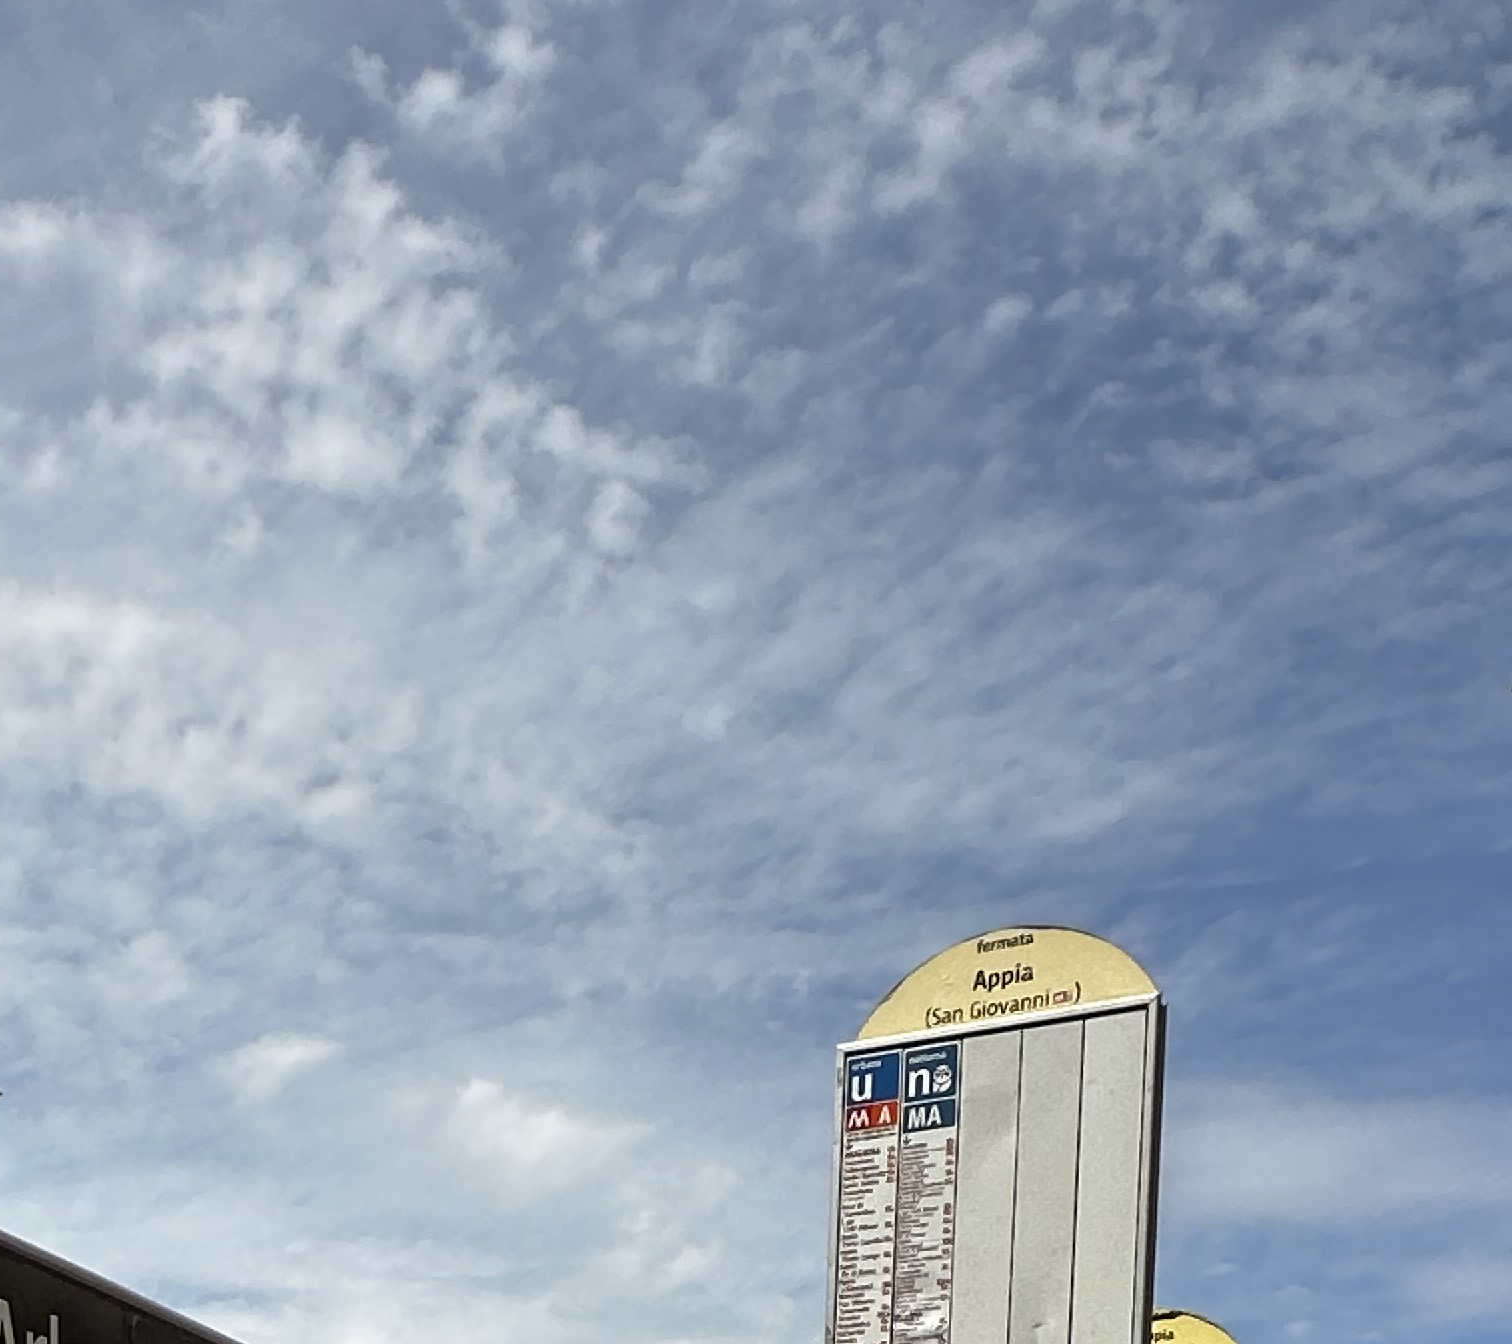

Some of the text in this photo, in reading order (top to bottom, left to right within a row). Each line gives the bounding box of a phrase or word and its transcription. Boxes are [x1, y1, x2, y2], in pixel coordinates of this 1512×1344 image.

[976, 932, 1034, 954] fermata
[973, 963, 1034, 993] Appia
[925, 1006, 964, 1028] (San
[970, 990, 1050, 1020] Giovanni
[852, 1073, 873, 1102] u
[908, 1104, 942, 1130] MA
